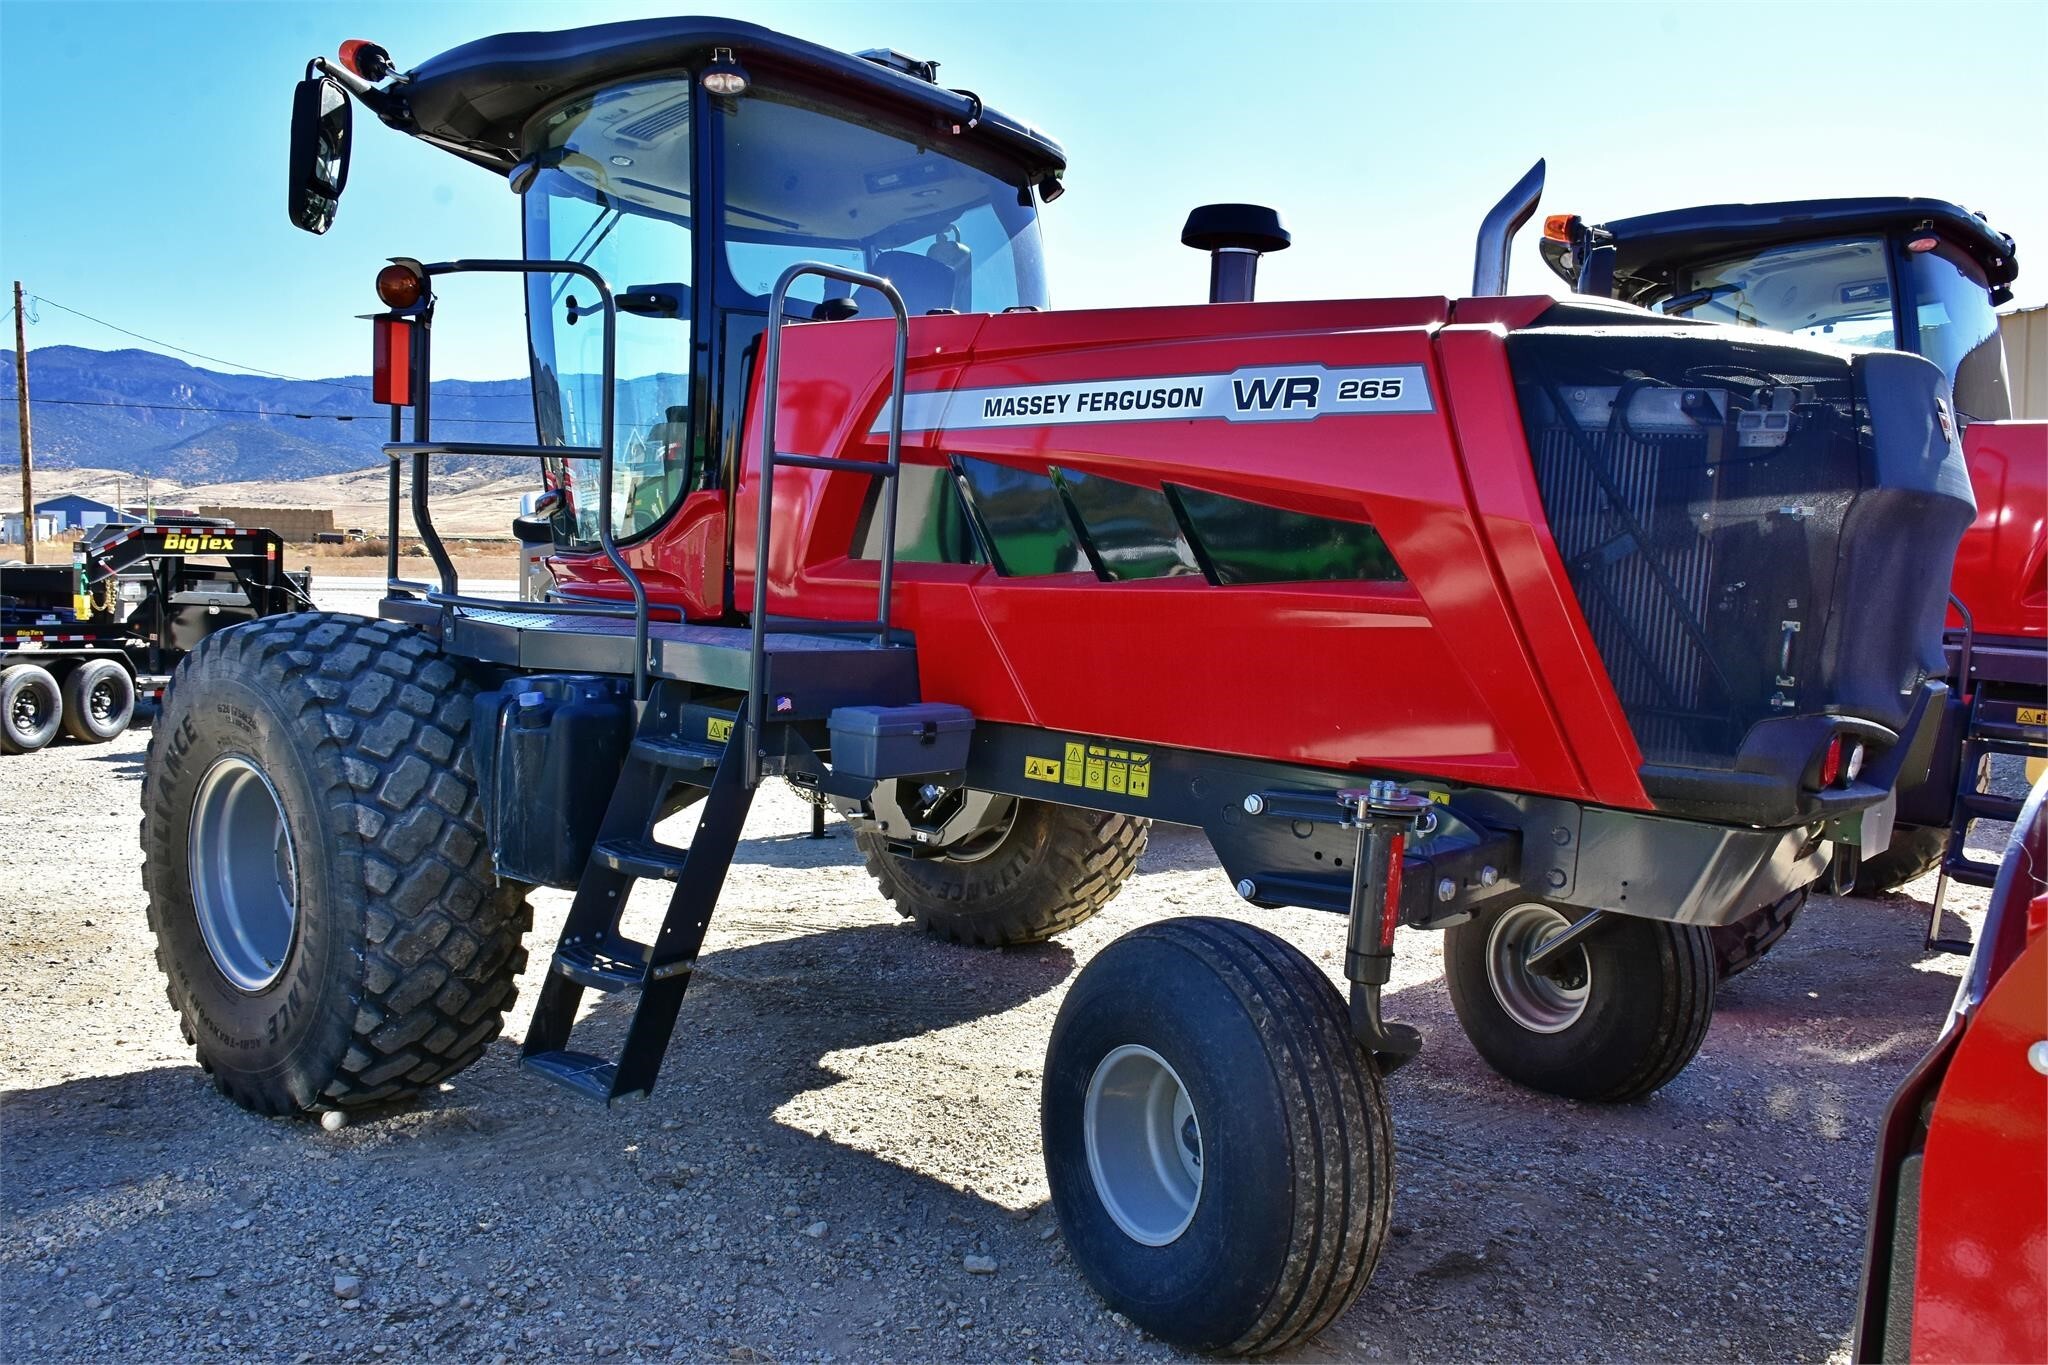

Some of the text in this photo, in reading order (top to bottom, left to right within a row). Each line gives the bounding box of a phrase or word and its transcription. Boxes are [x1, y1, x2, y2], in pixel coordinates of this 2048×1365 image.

[984, 376, 1402, 417] MASSEY FERGUSON WR 265
[163, 533, 234, 554] BigTex
